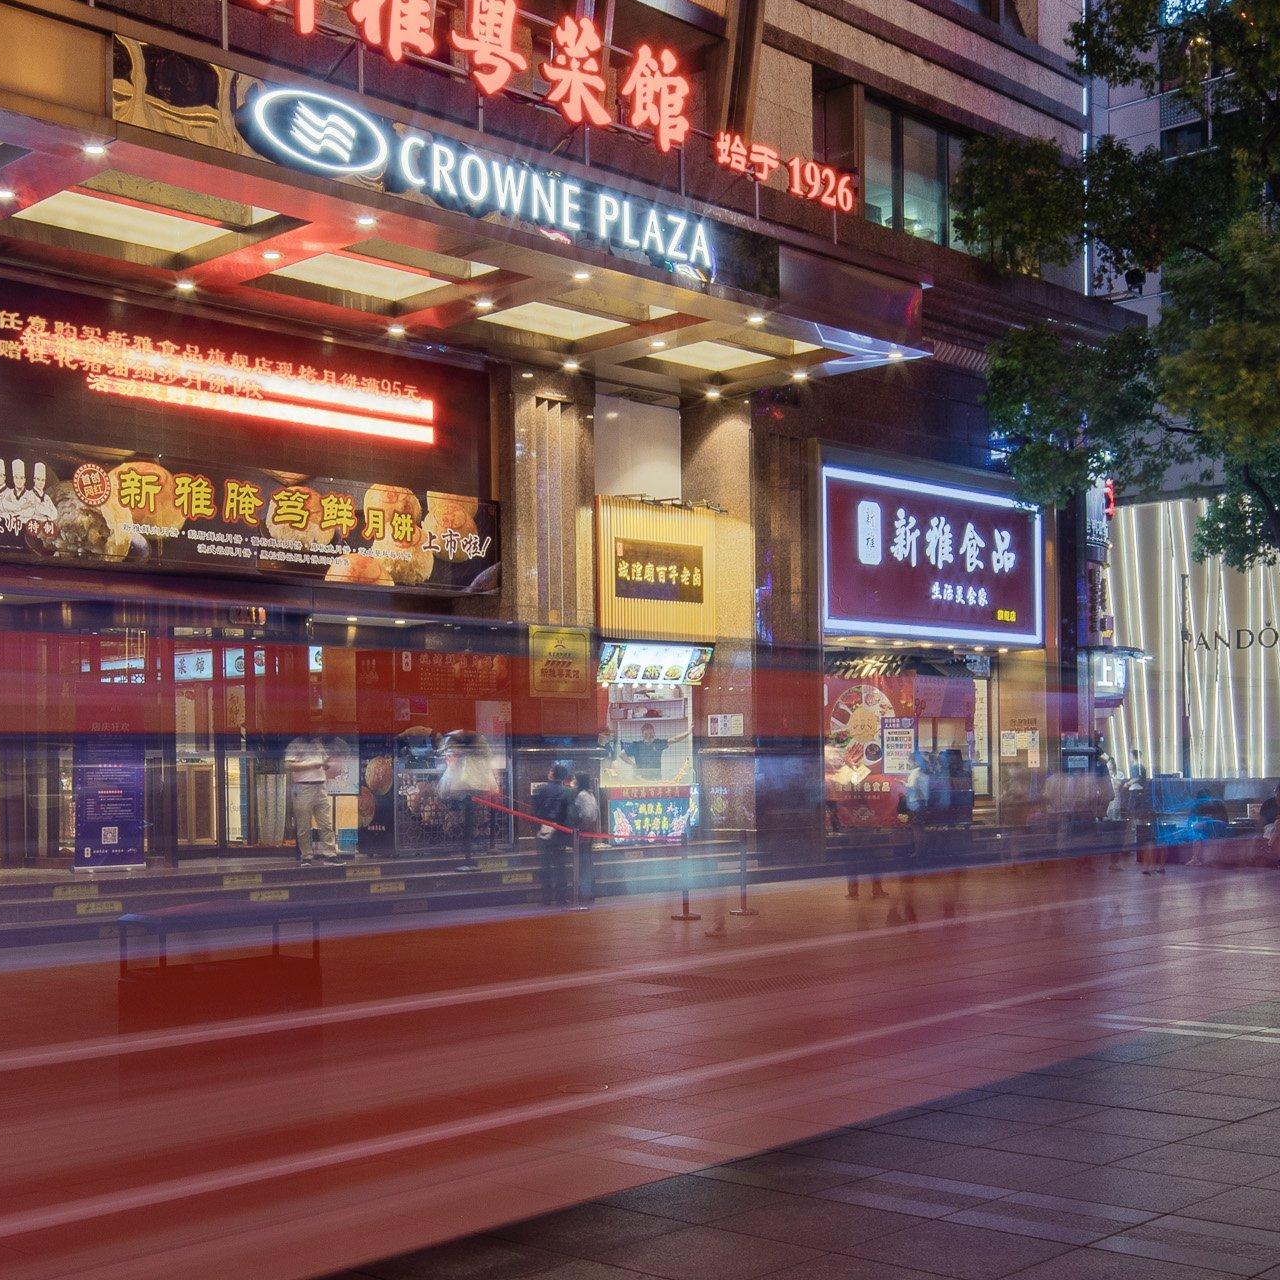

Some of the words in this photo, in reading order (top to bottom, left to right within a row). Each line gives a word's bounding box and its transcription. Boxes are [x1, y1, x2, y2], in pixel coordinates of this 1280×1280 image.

[401, 136, 582, 231] CROWNE
[599, 194, 713, 268] PLAZA
[788, 156, 855, 213] 1926
[27, 519, 55, 535] 特制
[890, 508, 1016, 574] 新雅食品
[930, 581, 989, 607] 生活美食家
